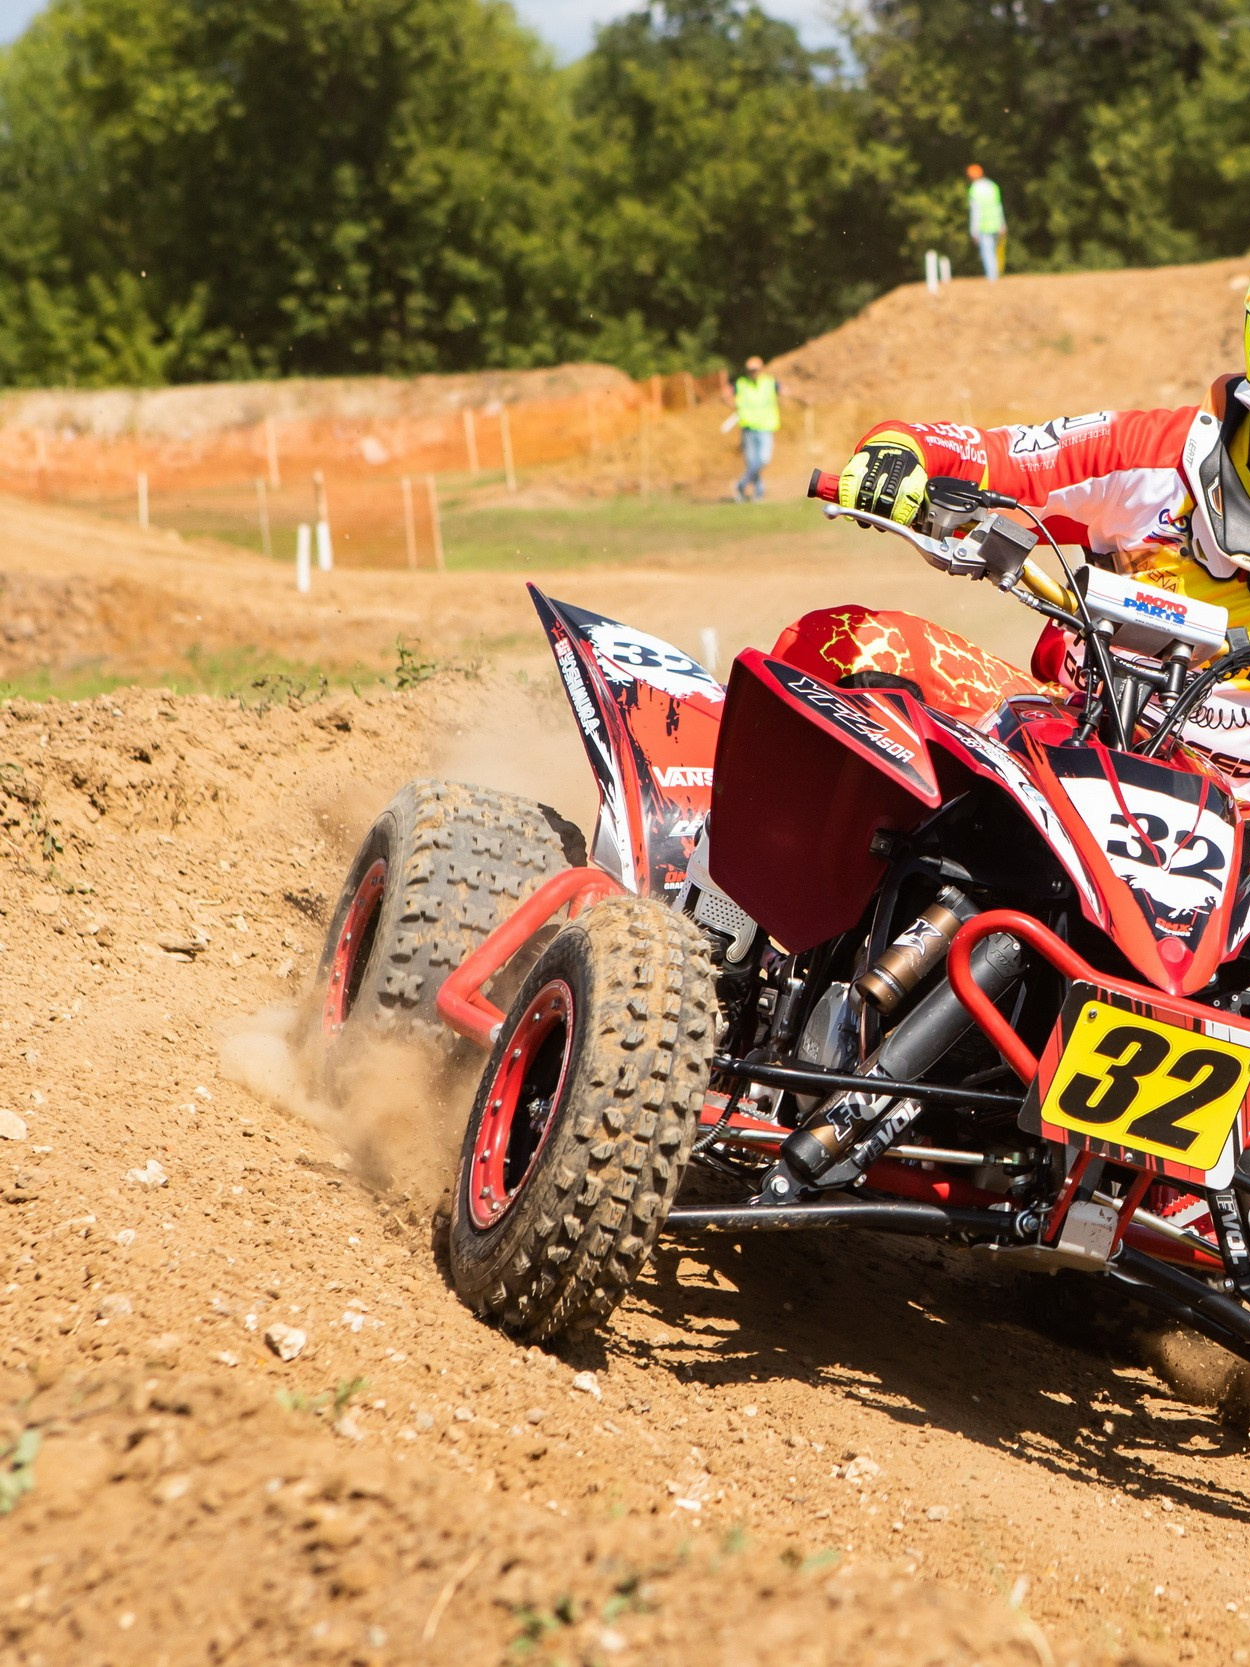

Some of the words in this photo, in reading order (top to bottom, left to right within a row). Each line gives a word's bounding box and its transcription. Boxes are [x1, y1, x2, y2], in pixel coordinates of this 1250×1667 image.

[1060, 427, 1111, 450] REDEFININ
[1123, 597, 1186, 625] PARTS
[1136, 591, 1188, 616] MOTO
[612, 641, 713, 684] 32
[558, 650, 601, 736] YOSHIMURA
[1106, 812, 1225, 891] 32
[1058, 1025, 1242, 1152] 32
